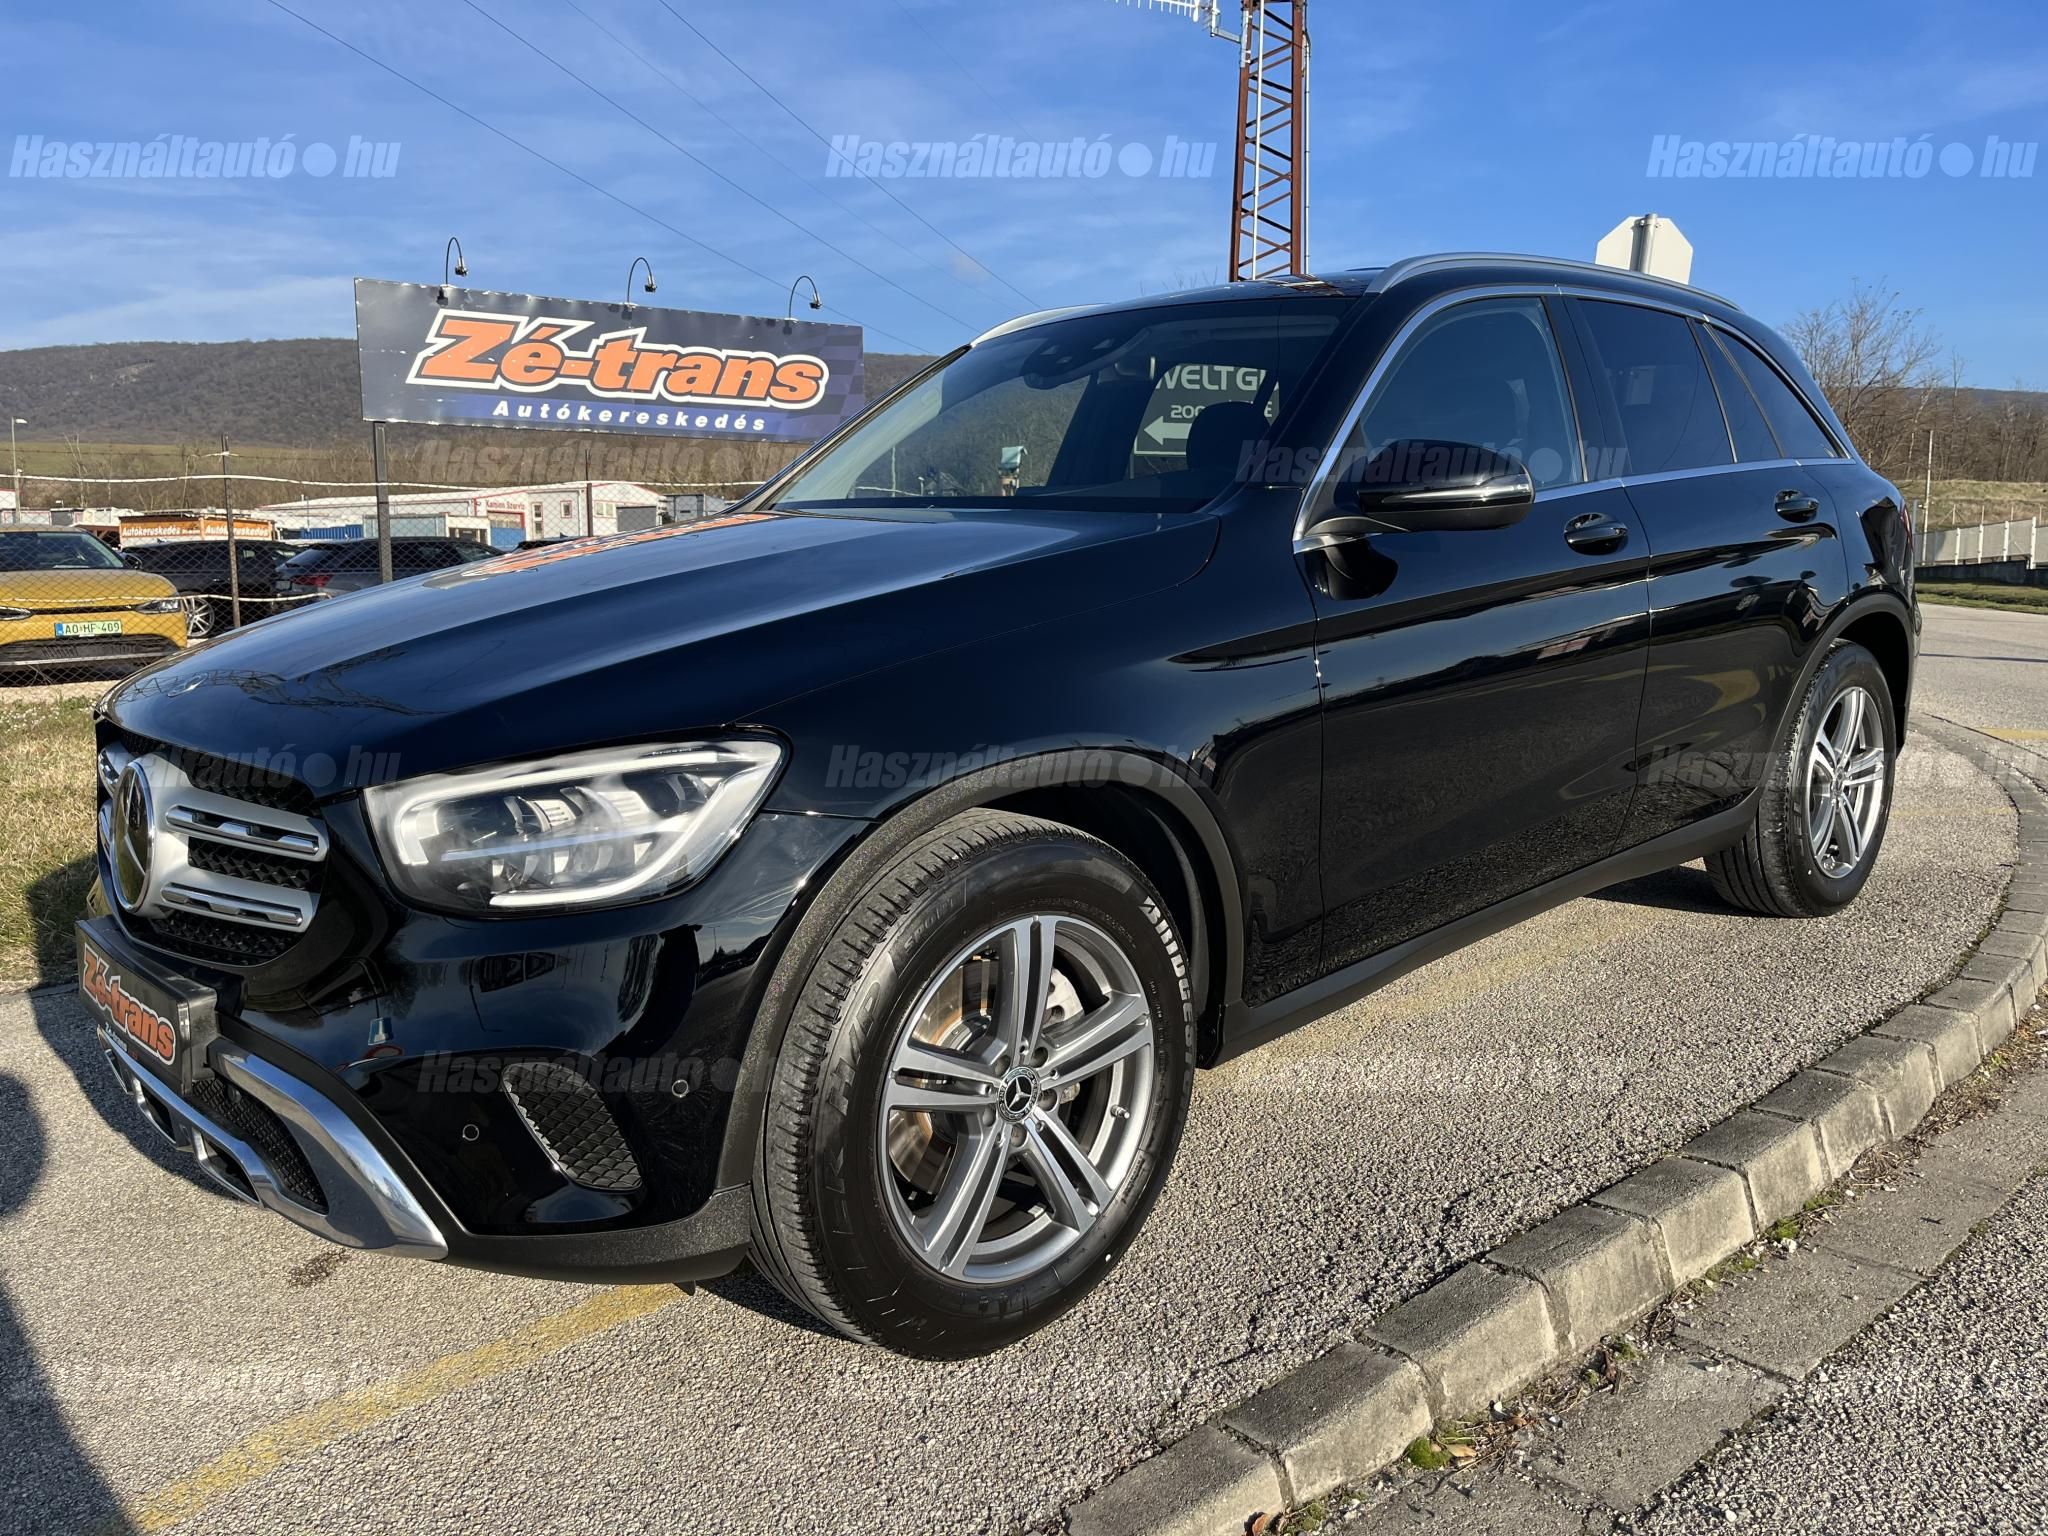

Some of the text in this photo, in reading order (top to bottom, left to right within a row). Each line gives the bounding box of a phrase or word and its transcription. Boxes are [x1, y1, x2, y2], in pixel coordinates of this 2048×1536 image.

[408, 310, 827, 409] Zé-trans
[1155, 365, 1279, 391] WELTG
[492, 400, 766, 432] Autókereskedés
[205, 525, 269, 537] Autókreskedés
[83, 943, 177, 1066] Zé-trans
